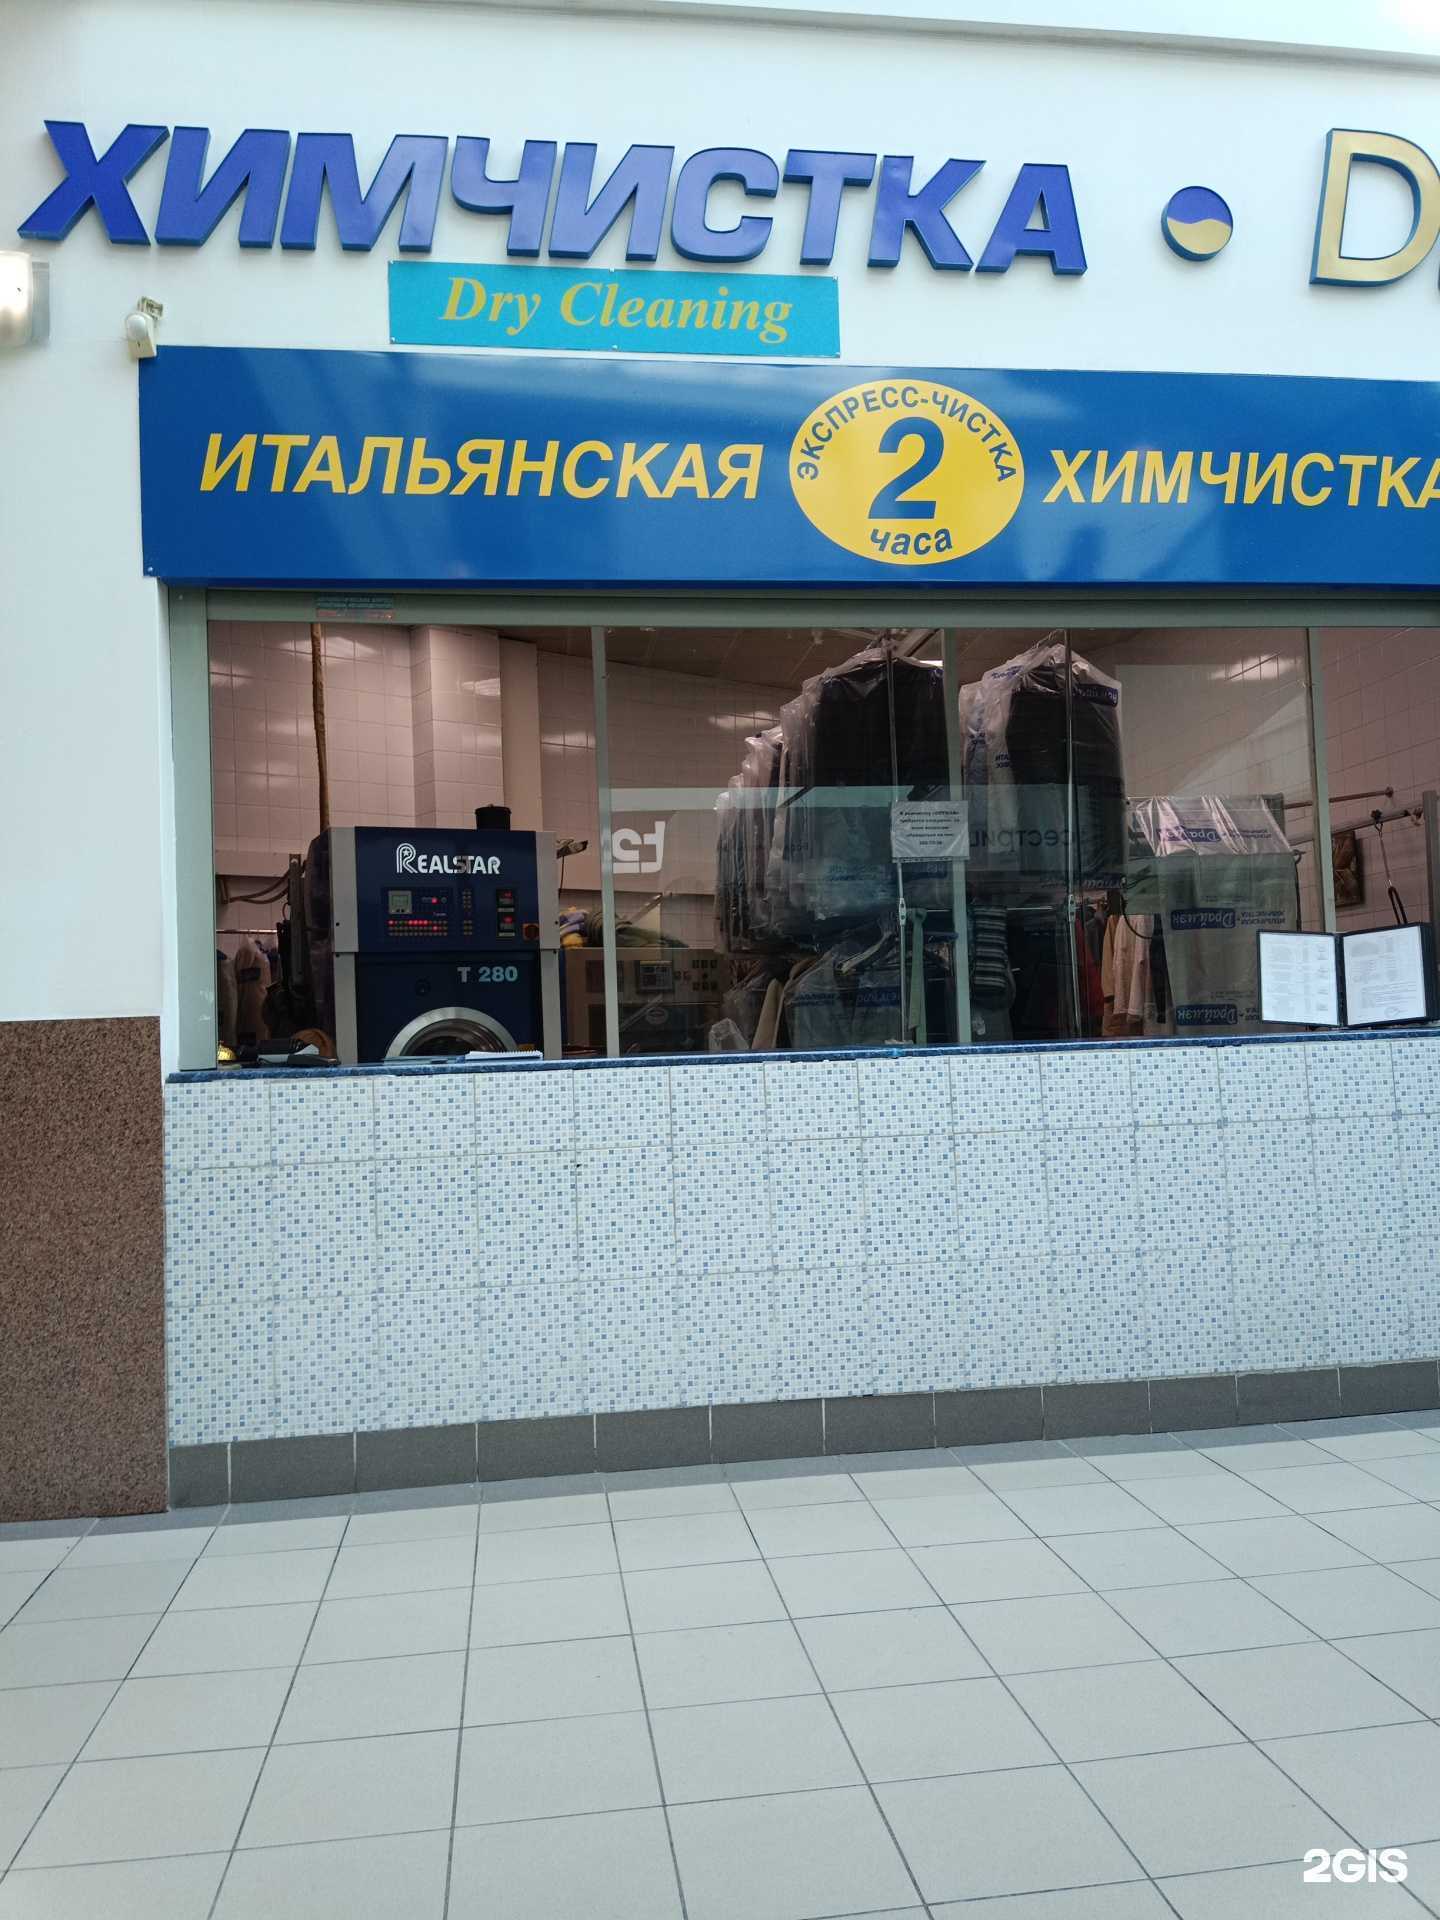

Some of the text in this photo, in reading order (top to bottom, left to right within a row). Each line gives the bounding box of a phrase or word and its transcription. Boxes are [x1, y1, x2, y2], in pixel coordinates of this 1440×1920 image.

[18, 120, 1088, 276] ХИМЧИСТКА
[1309, 128, 1440, 291] D
[438, 276, 793, 344] Dry Cleaning
[200, 433, 763, 500] ИТАЛЬЯНСКАЯ
[797, 386, 1017, 482] ЭКСПРЕСС-ЧИСТКА
[868, 416, 945, 519] 2
[1043, 449, 1440, 509] ХИМЧИСТКА
[870, 527, 953, 555] часа
[396, 843, 501, 875] REALSTAR
[457, 966, 518, 982] T 280
